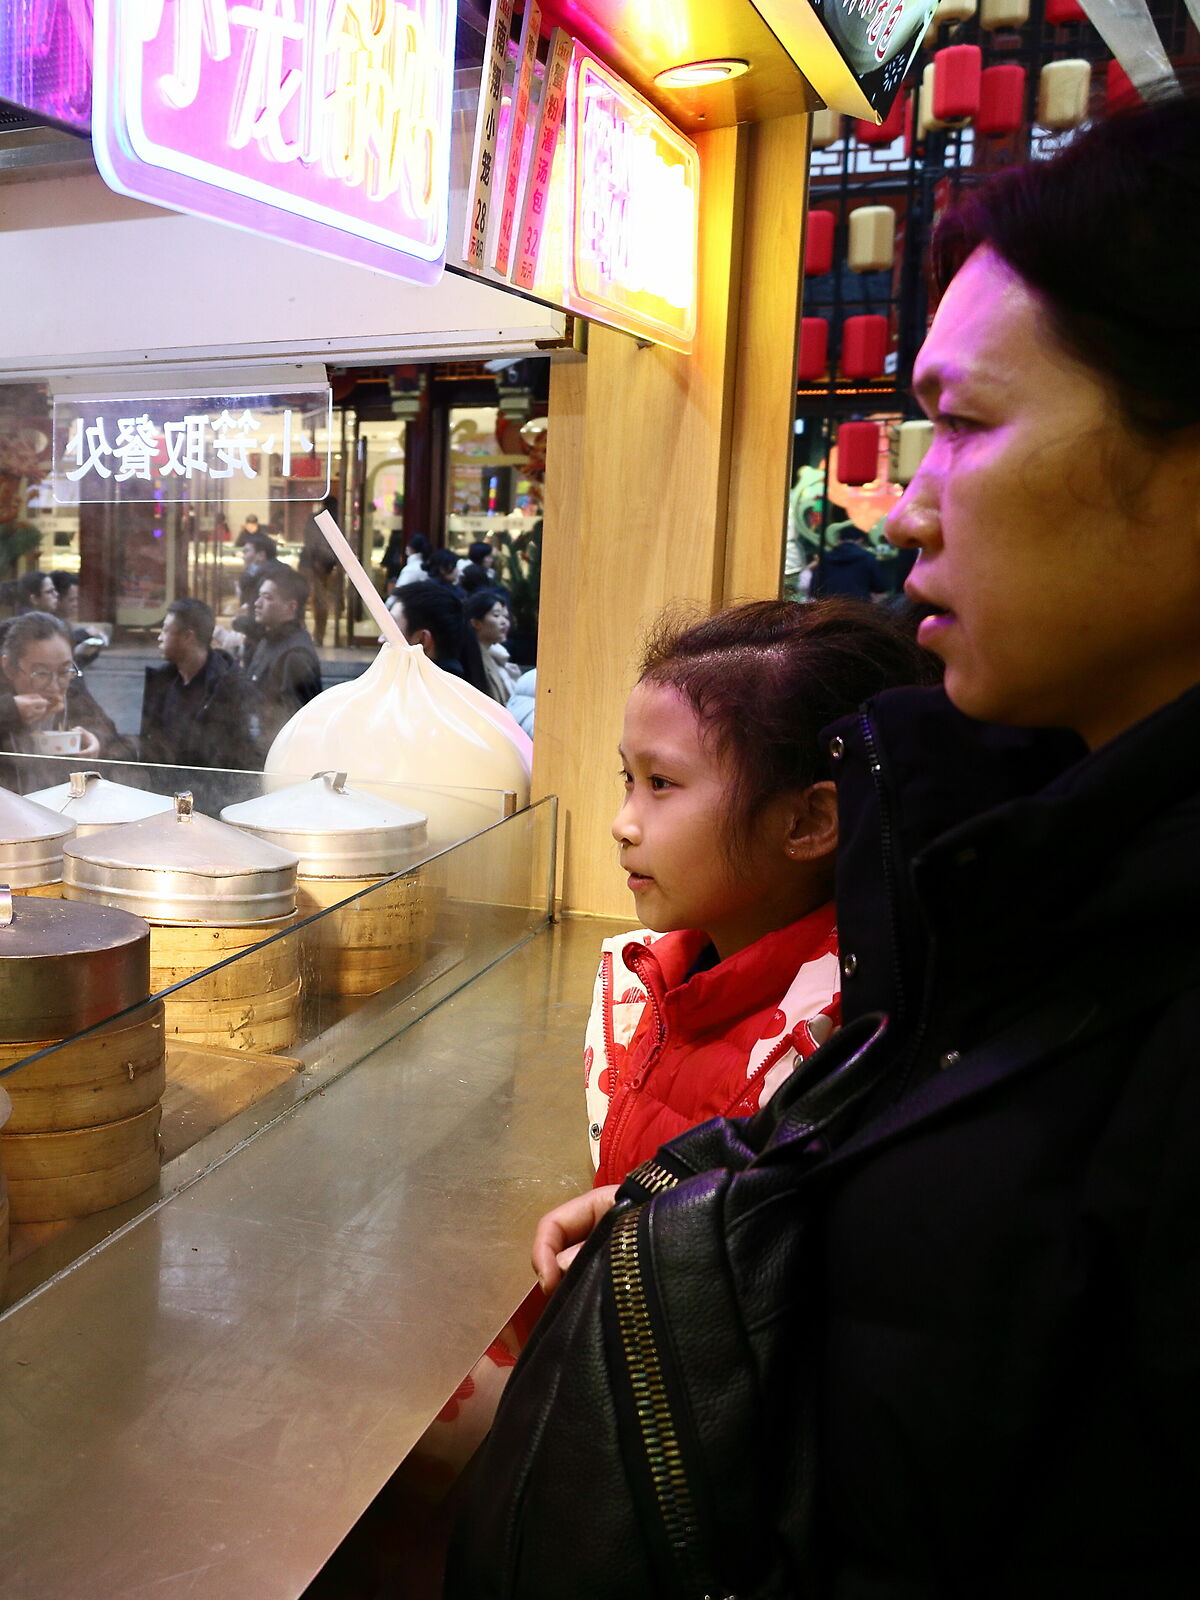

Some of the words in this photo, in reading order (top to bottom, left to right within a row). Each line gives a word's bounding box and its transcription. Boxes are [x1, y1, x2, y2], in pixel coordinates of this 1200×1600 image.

[480, 19, 508, 187] 南翔小笼
[474, 198, 487, 234] 28
[524, 226, 539, 257] 32
